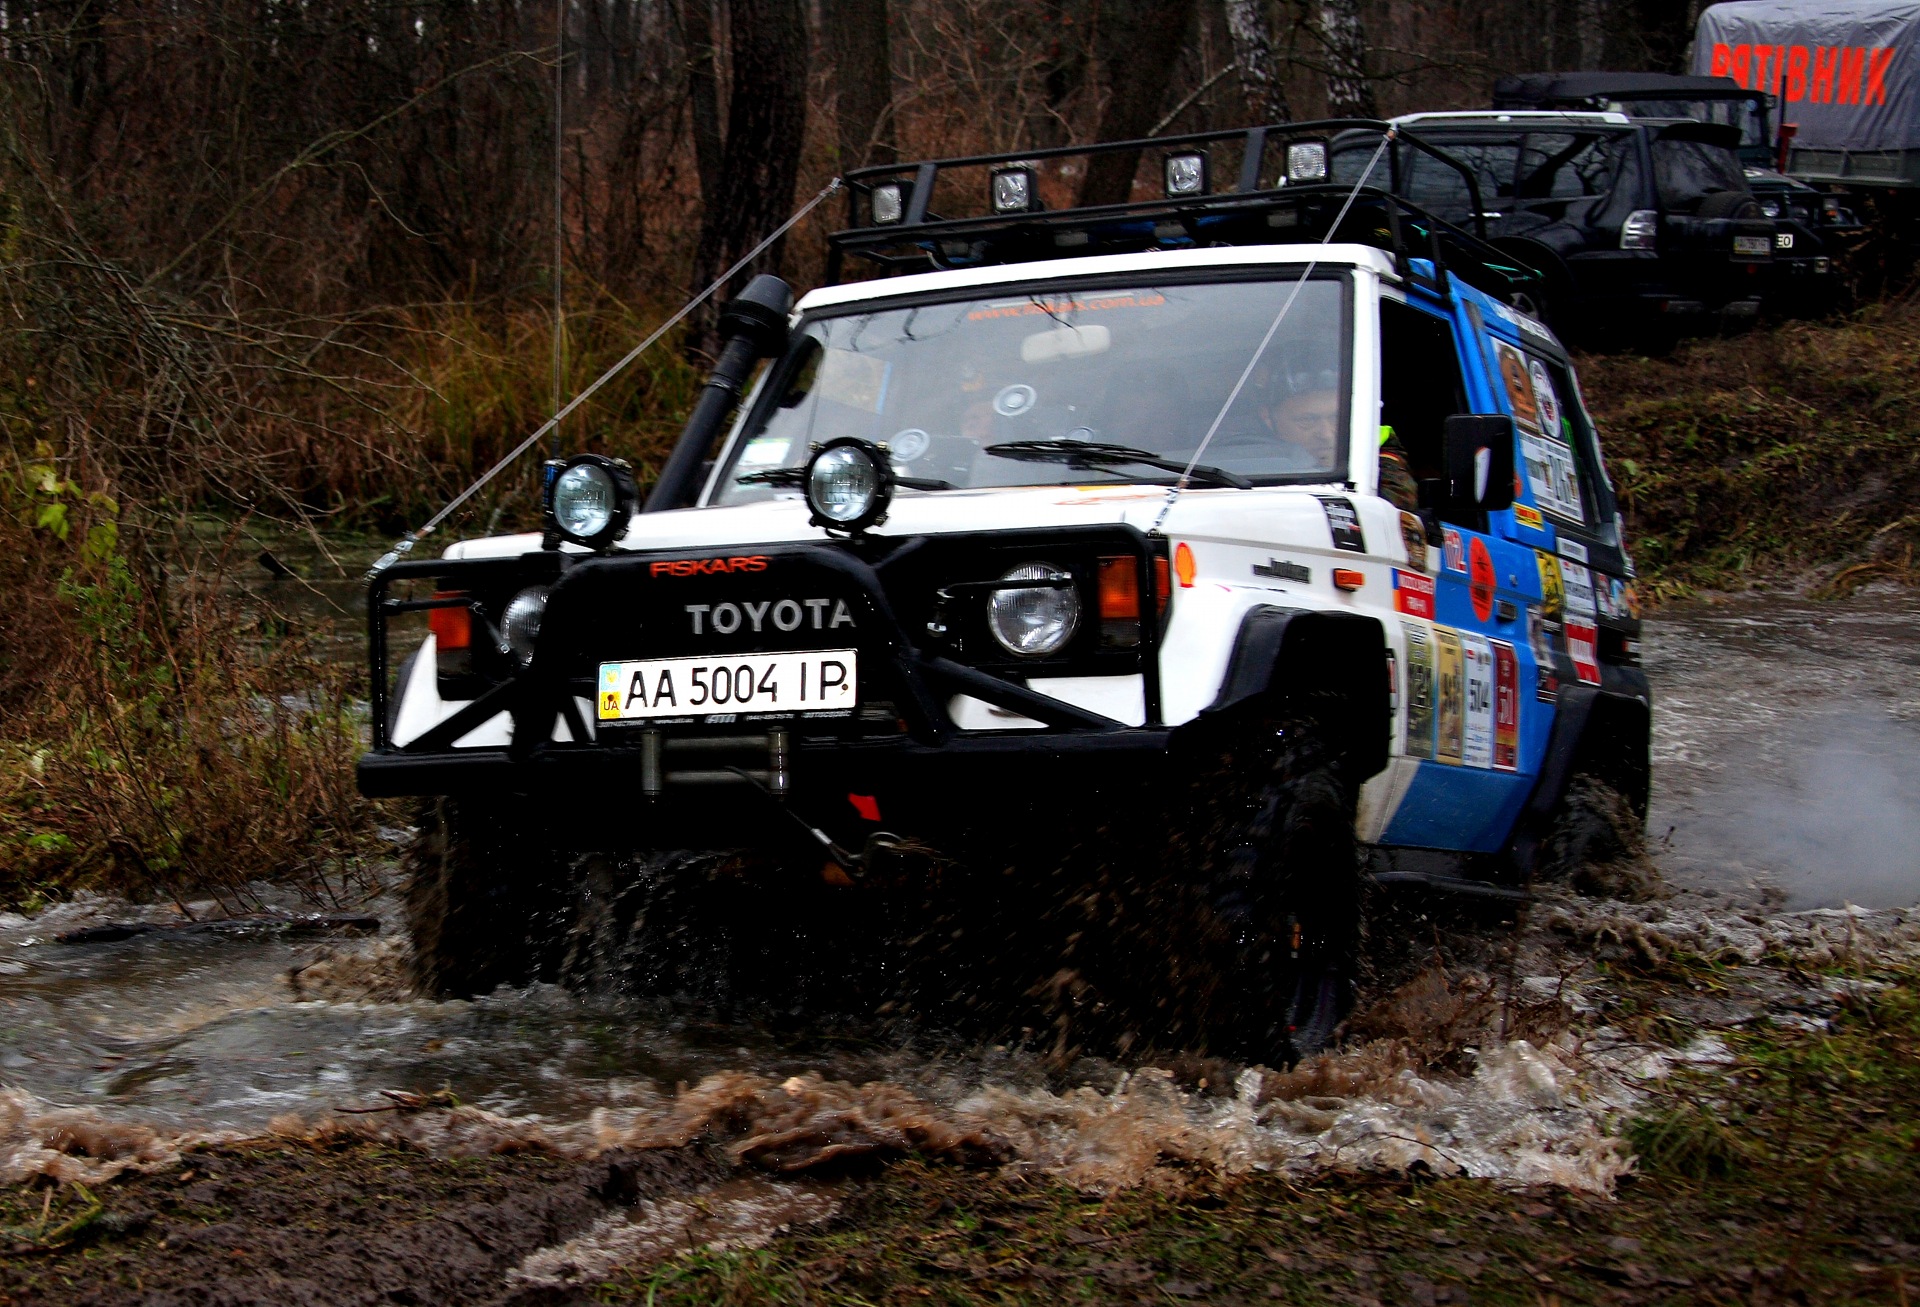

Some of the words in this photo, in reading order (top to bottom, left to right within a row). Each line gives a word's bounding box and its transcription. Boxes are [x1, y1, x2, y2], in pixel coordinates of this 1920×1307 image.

[650, 556, 772, 578] FISKARS
[684, 598, 857, 635] TOYOTA
[625, 669, 678, 710] AA
[689, 663, 779, 706] 5004
[800, 660, 848, 702] IP
[603, 700, 620, 711] UA
